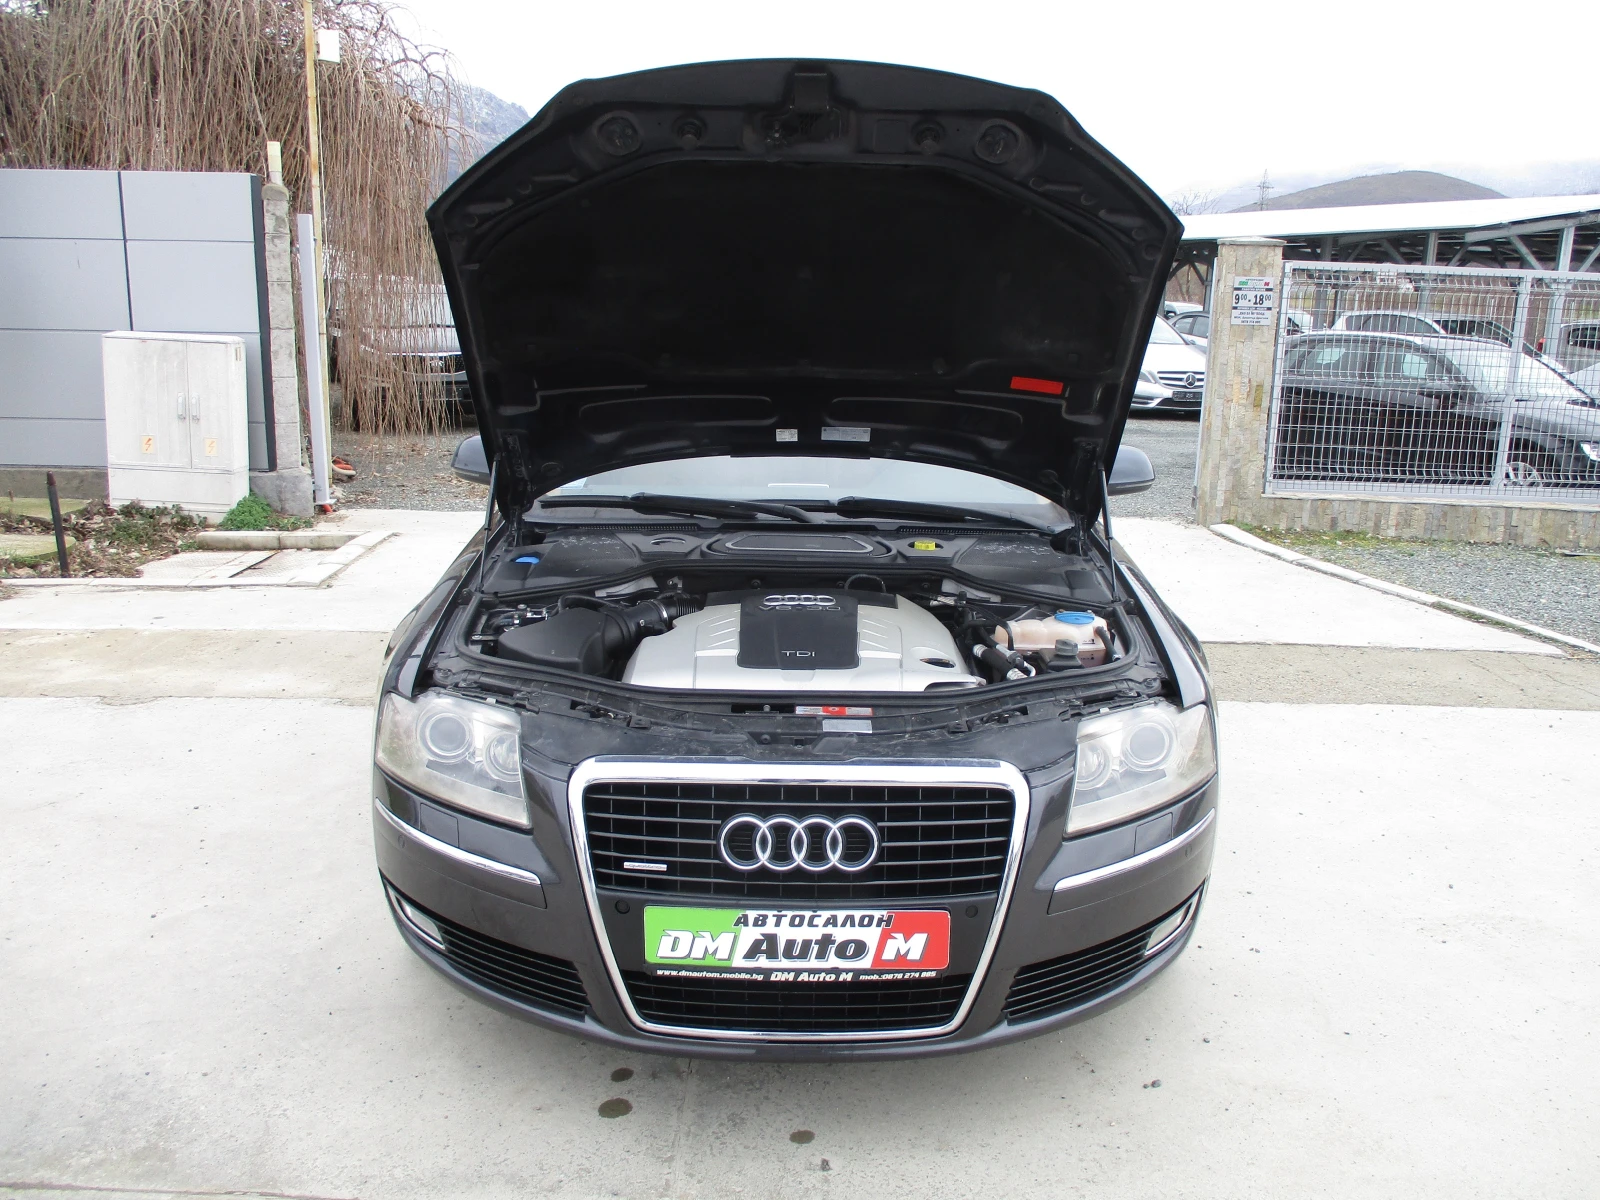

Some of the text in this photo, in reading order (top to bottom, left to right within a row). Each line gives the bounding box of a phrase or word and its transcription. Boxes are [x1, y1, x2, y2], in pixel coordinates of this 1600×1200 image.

[733, 913, 894, 928] АВТОСАЛОН
[656, 929, 930, 962] DM Auto M
[656, 968, 764, 981] www.dmautom.mobile.bg
[770, 971, 795, 981] DM
[797, 971, 836, 982] Auto
[838, 971, 854, 982] M
